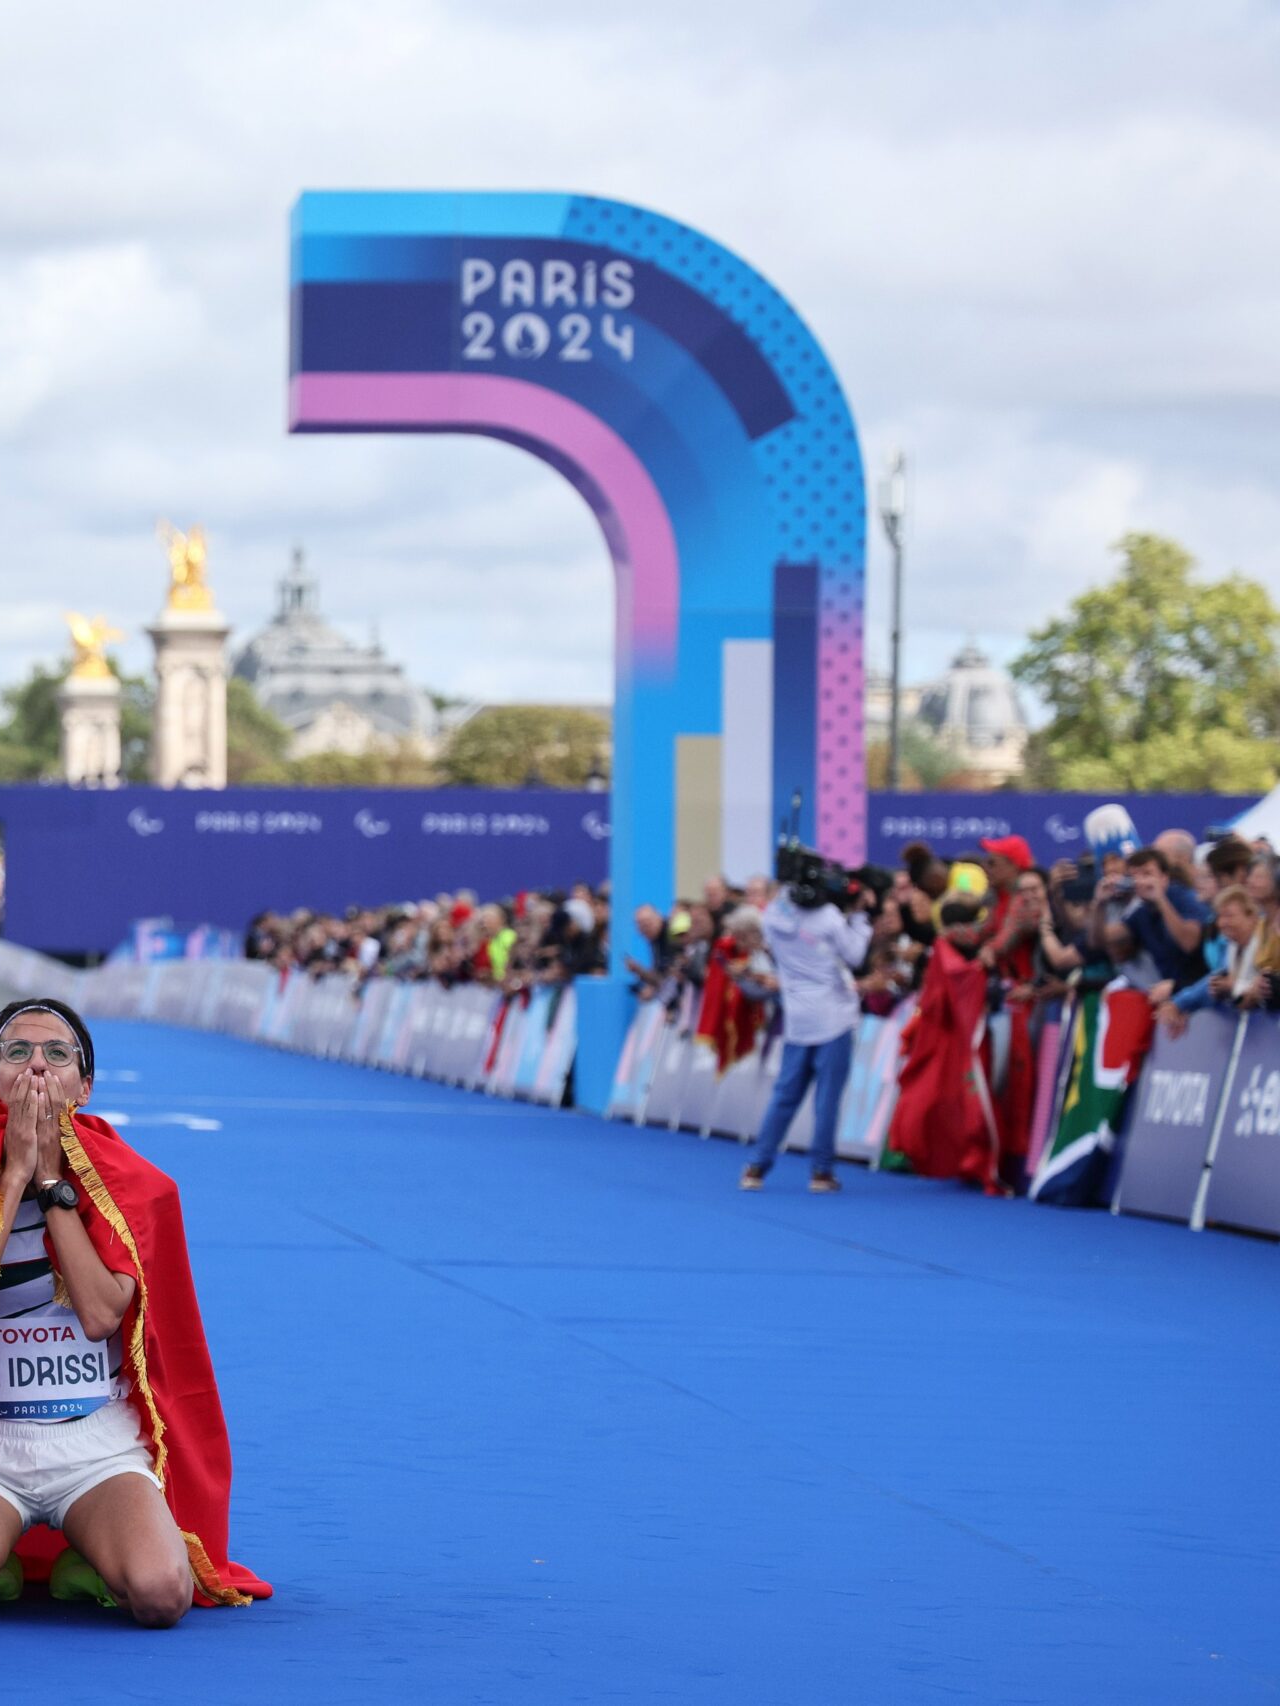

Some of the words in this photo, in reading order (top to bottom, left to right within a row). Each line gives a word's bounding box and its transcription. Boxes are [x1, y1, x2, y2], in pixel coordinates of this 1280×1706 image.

[462, 258, 634, 308] PARIS
[461, 312, 634, 362] 2024
[8, 1351, 105, 1388] IDRISSI
[14, 1405, 48, 1415] PARIS
[52, 1403, 83, 1413] 2024
